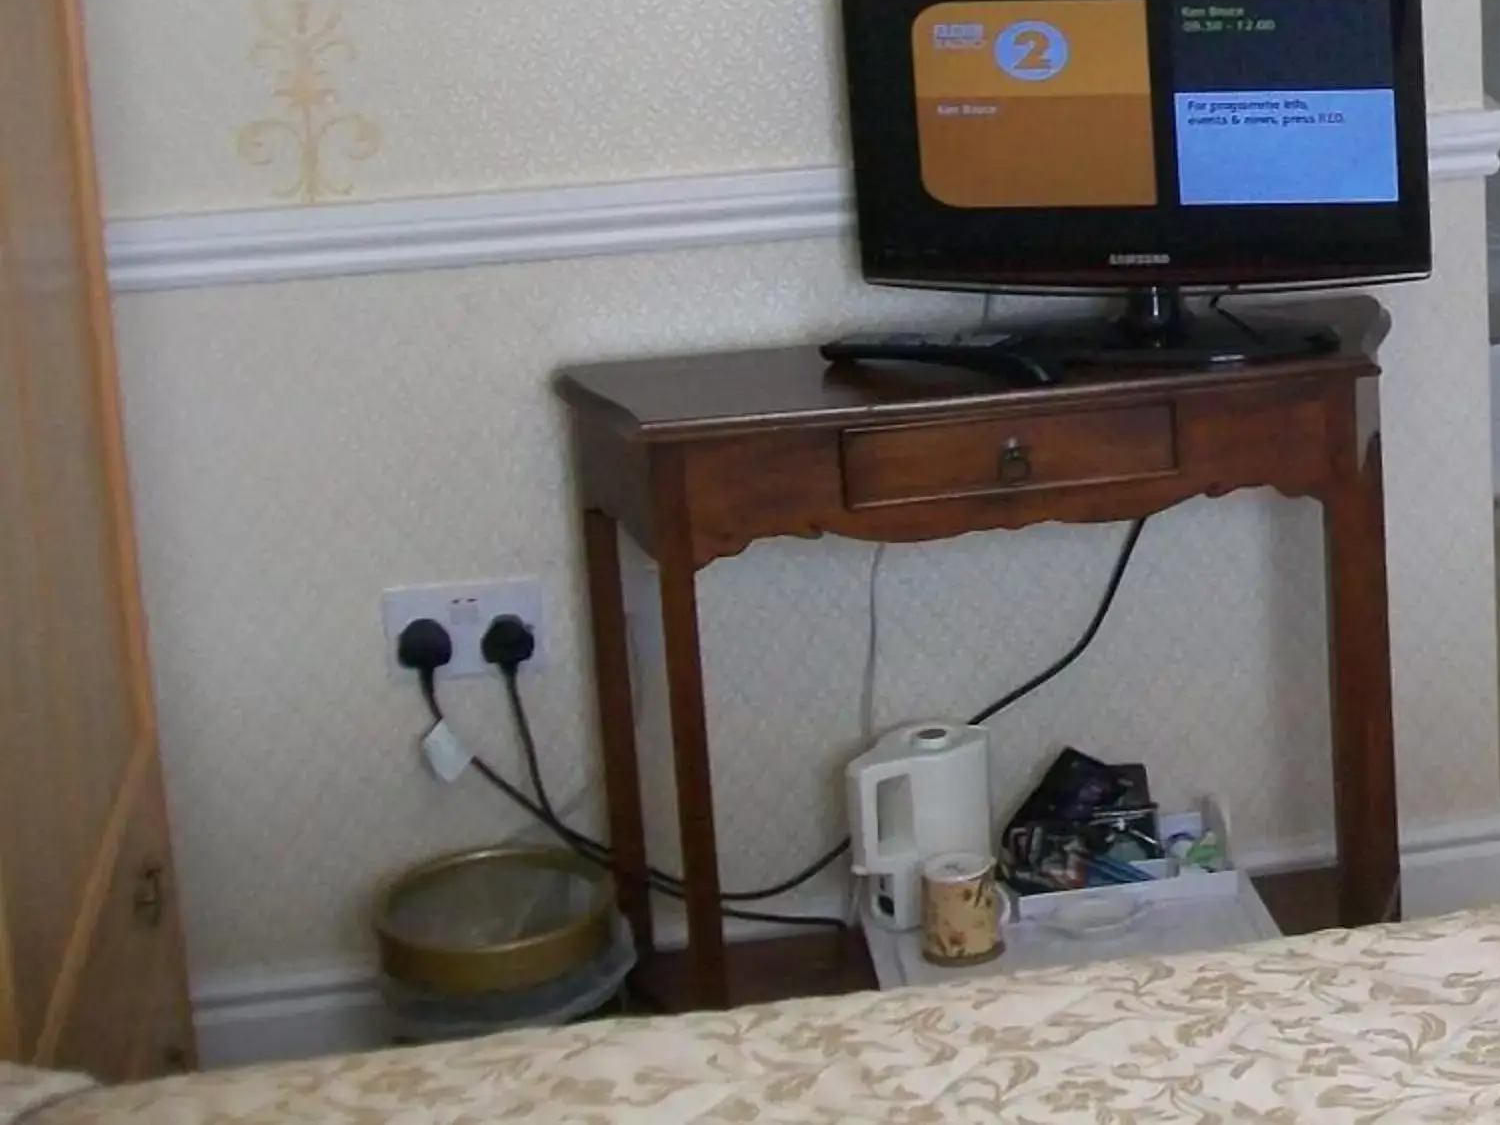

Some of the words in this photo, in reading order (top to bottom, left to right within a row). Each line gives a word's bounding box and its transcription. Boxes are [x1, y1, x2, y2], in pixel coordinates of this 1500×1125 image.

[1013, 30, 1052, 69] 2
[1187, 100, 1206, 111] For
[1209, 101, 1280, 113] programme
[1187, 116, 1228, 126] events
[1281, 116, 1315, 127] press
[1109, 253, 1170, 265] SAMSUNG
